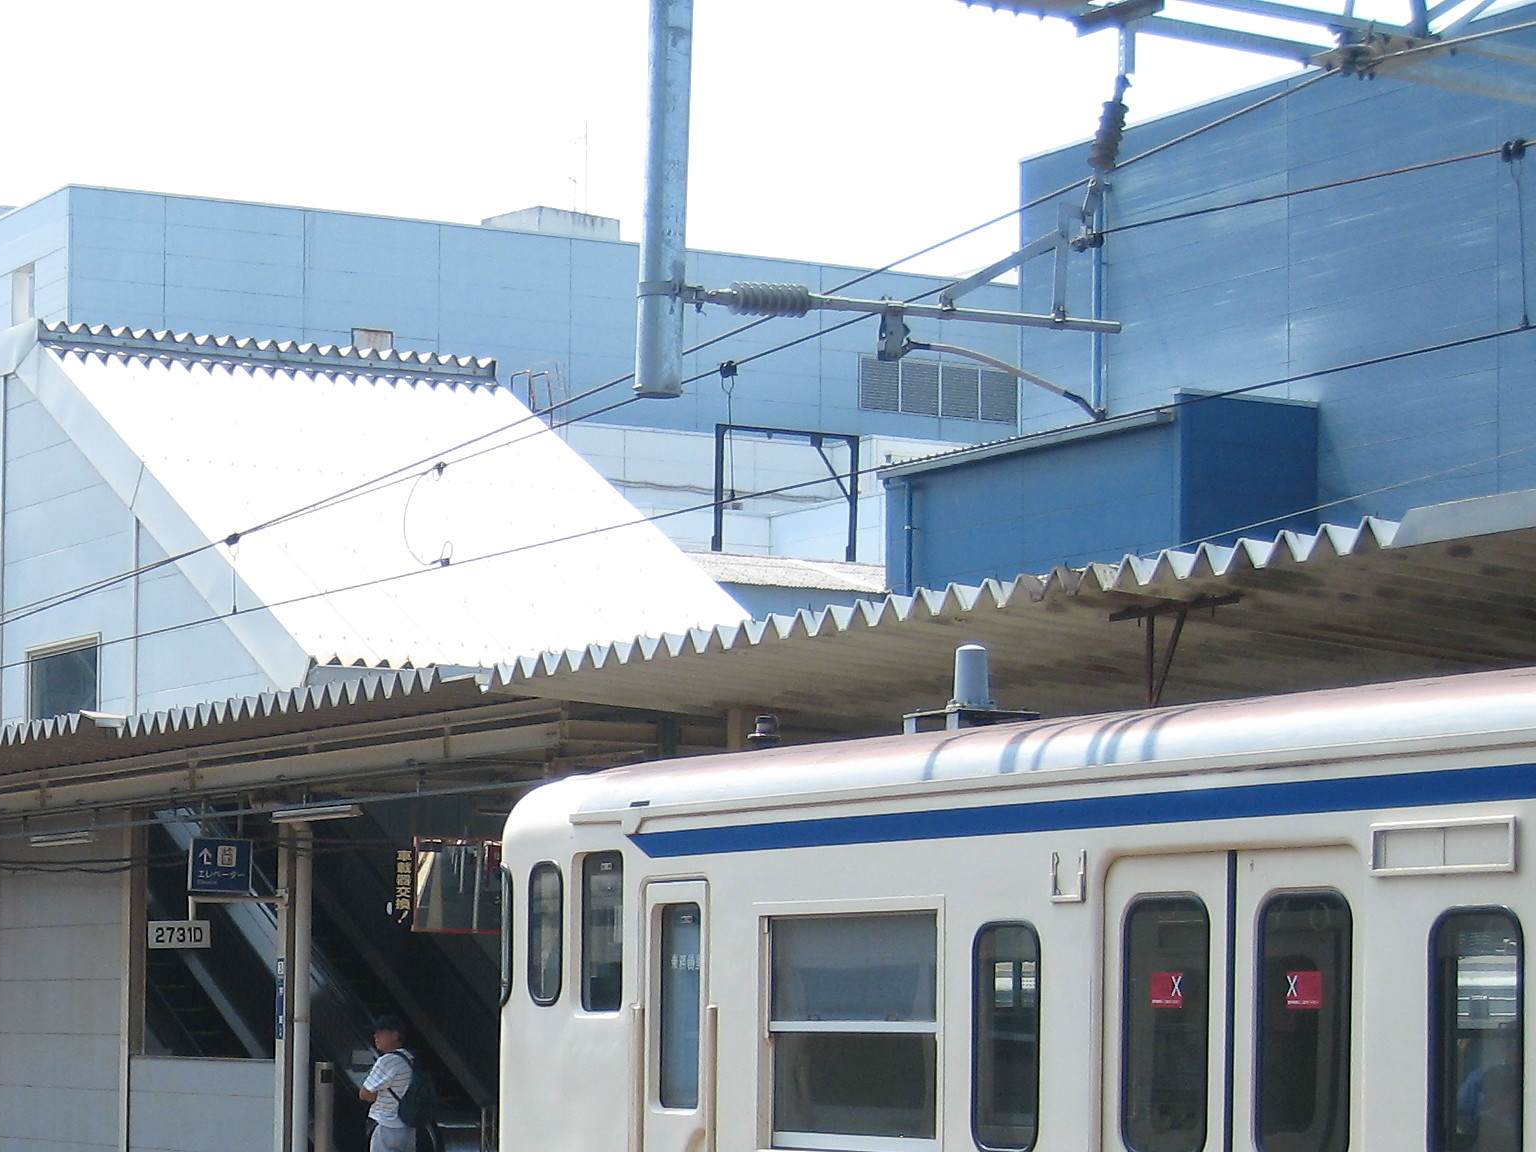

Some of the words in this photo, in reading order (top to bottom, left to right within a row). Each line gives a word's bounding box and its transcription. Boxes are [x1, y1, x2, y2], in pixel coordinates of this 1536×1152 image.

[197, 869, 245, 880] エレベーター
[155, 926, 203, 943] 2731D
